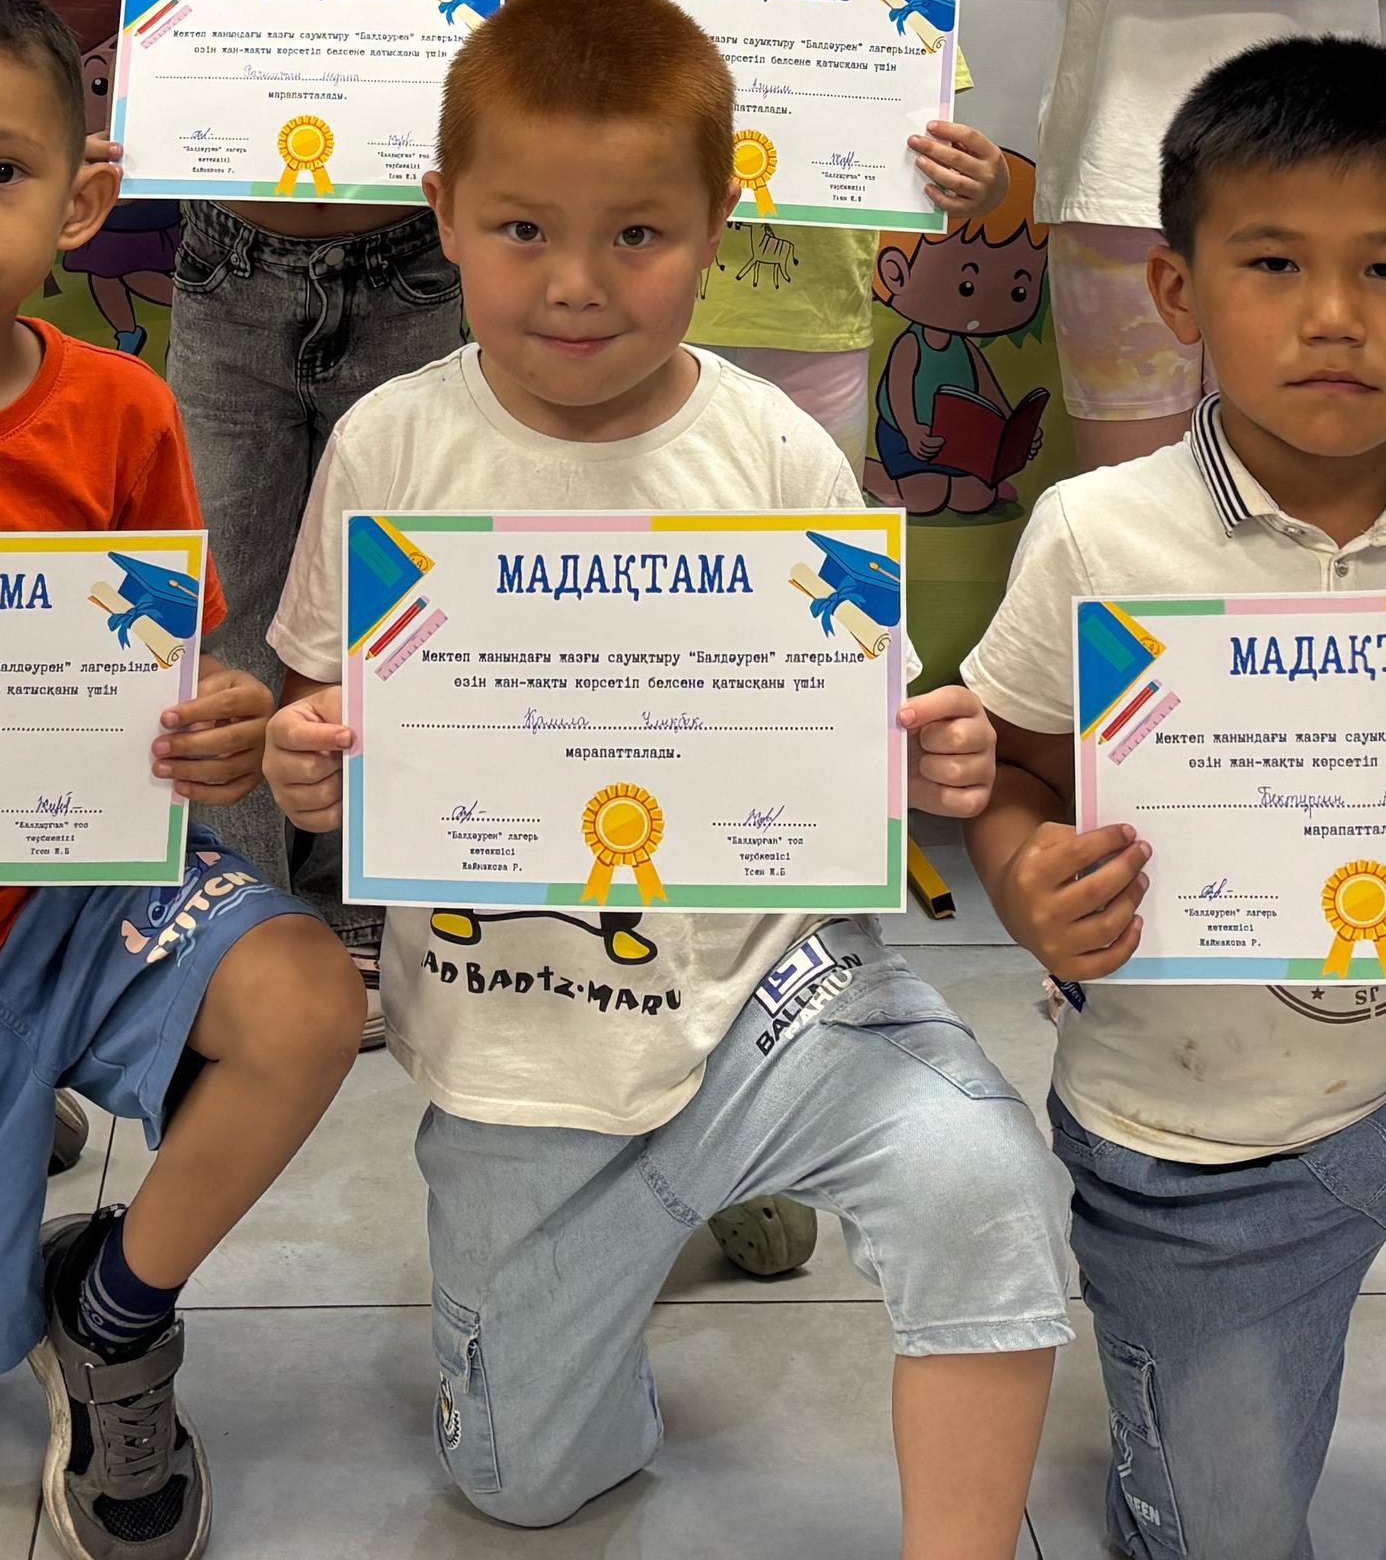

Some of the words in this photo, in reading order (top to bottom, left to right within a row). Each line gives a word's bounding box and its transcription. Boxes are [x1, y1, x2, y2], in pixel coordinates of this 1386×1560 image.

[496, 554, 754, 602] МАДАҚТАМА
[422, 650, 470, 663] Мектеп
[478, 652, 551, 664] жанындағы
[558, 652, 600, 664] жазғы
[607, 653, 681, 667] сауықтыру
[784, 651, 865, 667] лагерьінде
[79, 661, 159, 675] лагерьінде
[6, 685, 79, 696] қатысқаны
[86, 684, 118, 698] үшін
[453, 675, 487, 688] өзін
[494, 677, 568, 690] жан-жақты
[575, 676, 640, 692] көрсетіп
[647, 676, 705, 689] белсене
[712, 678, 785, 690] қатысқаны
[793, 676, 825, 692] үшін
[1155, 732, 1205, 745] Мектеп
[1212, 732, 1287, 744] жанындағы
[1295, 732, 1337, 743] жазғы
[565, 747, 681, 761] марапатталады.
[1188, 755, 1222, 769] өзін
[1229, 757, 1304, 769] жан-жақты
[1312, 755, 1378, 771] көрсетіп
[421, 950, 459, 984] AD
